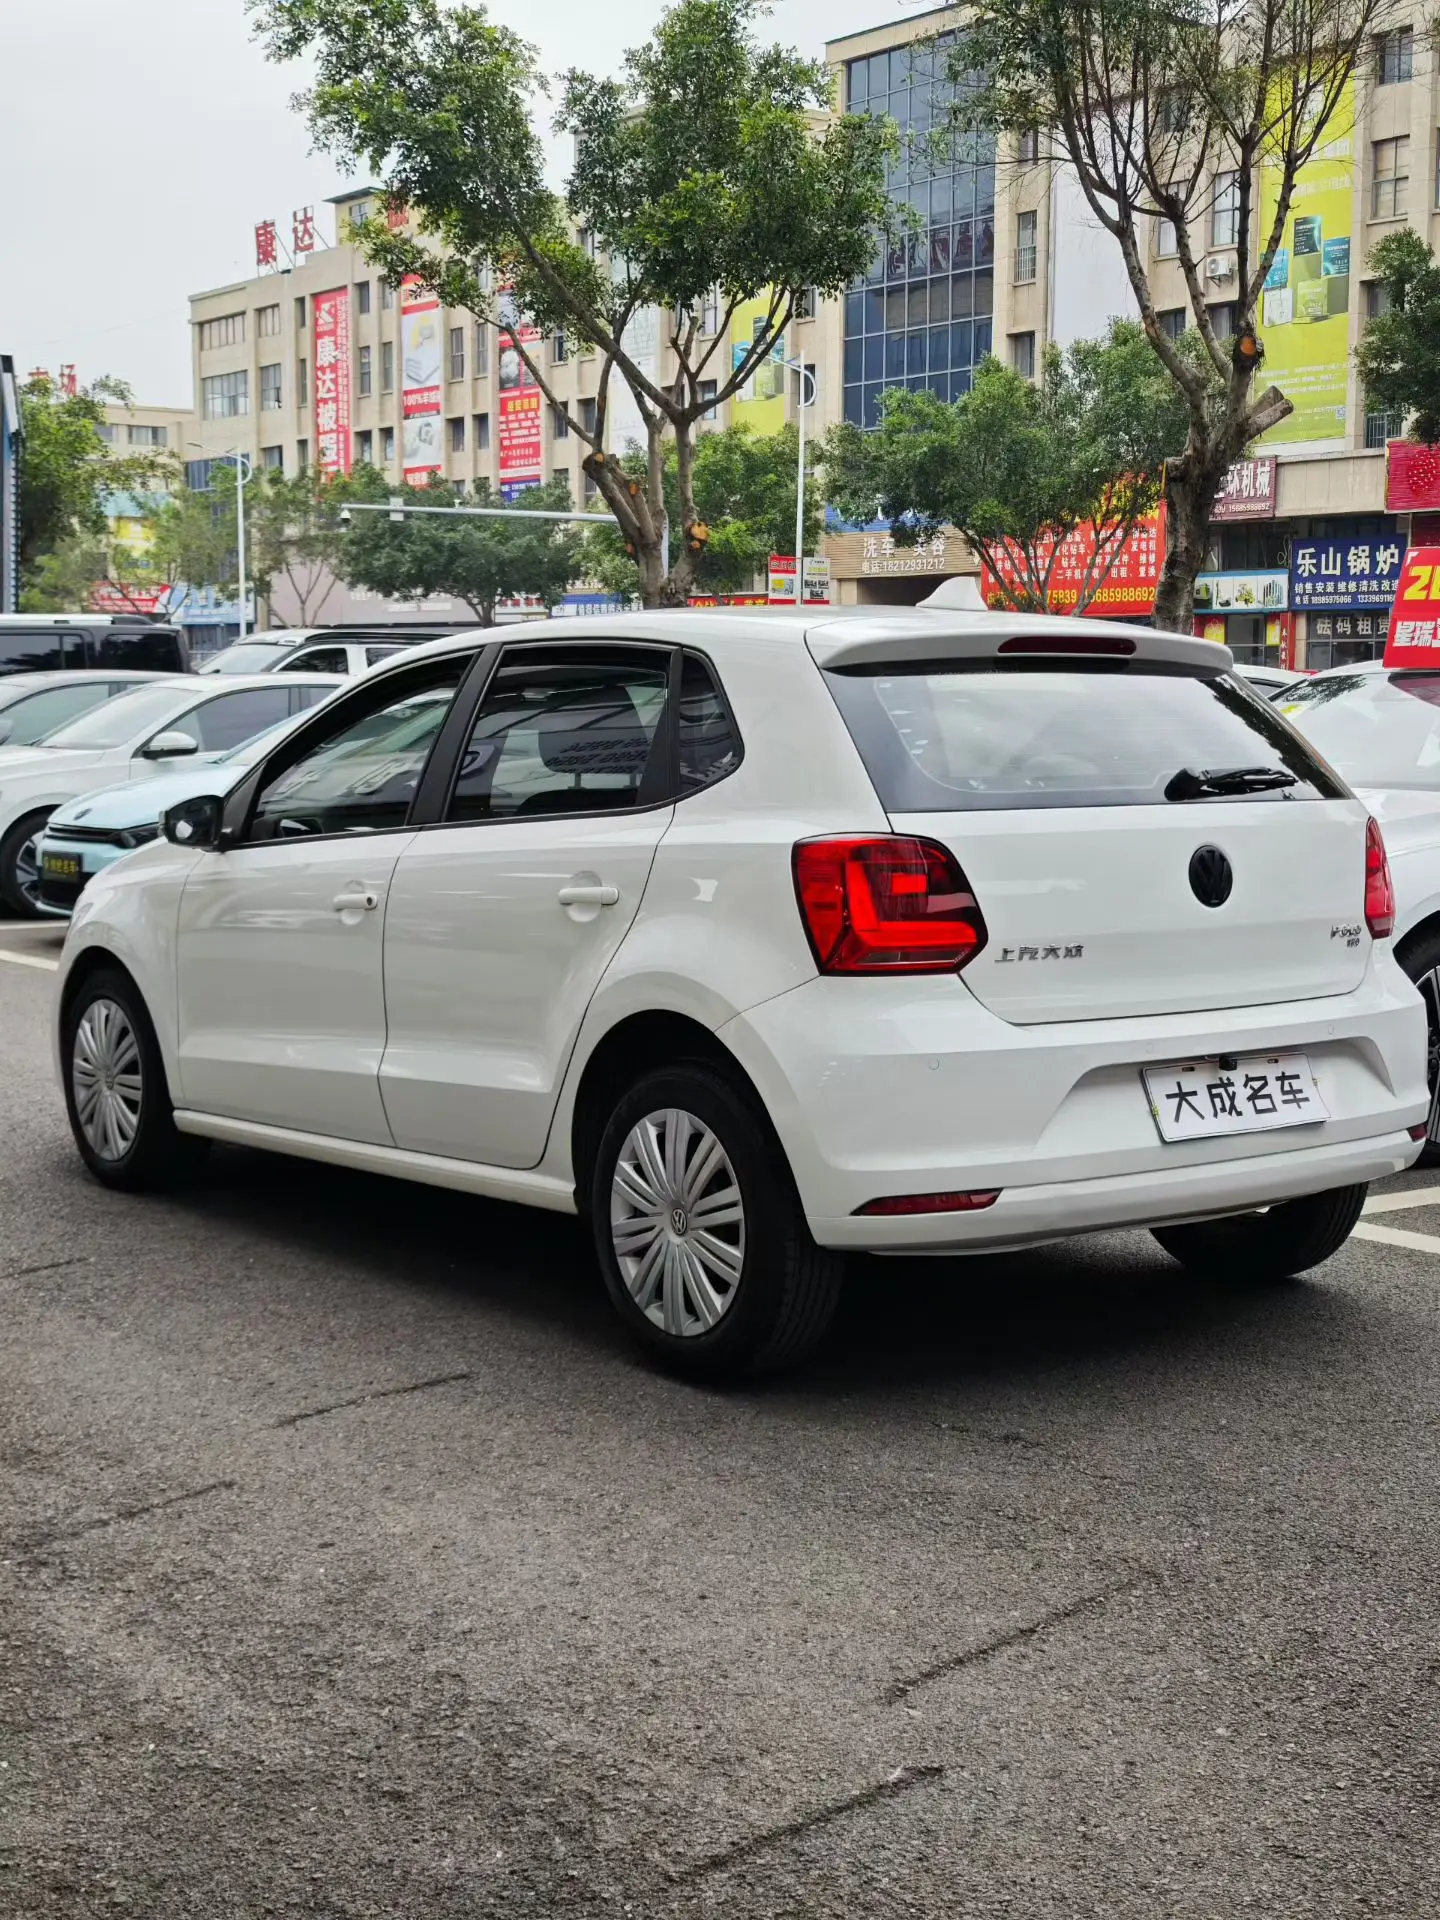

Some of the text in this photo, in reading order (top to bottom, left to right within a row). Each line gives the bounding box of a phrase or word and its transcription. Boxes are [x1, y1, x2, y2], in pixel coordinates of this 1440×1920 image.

[255, 206, 314, 266] 康达
[862, 536, 895, 558] 洗车
[1296, 543, 1399, 577] 乐山锅炉
[1084, 587, 1155, 603] 1685988692
[1164, 1071, 1311, 1123] 大成名车
